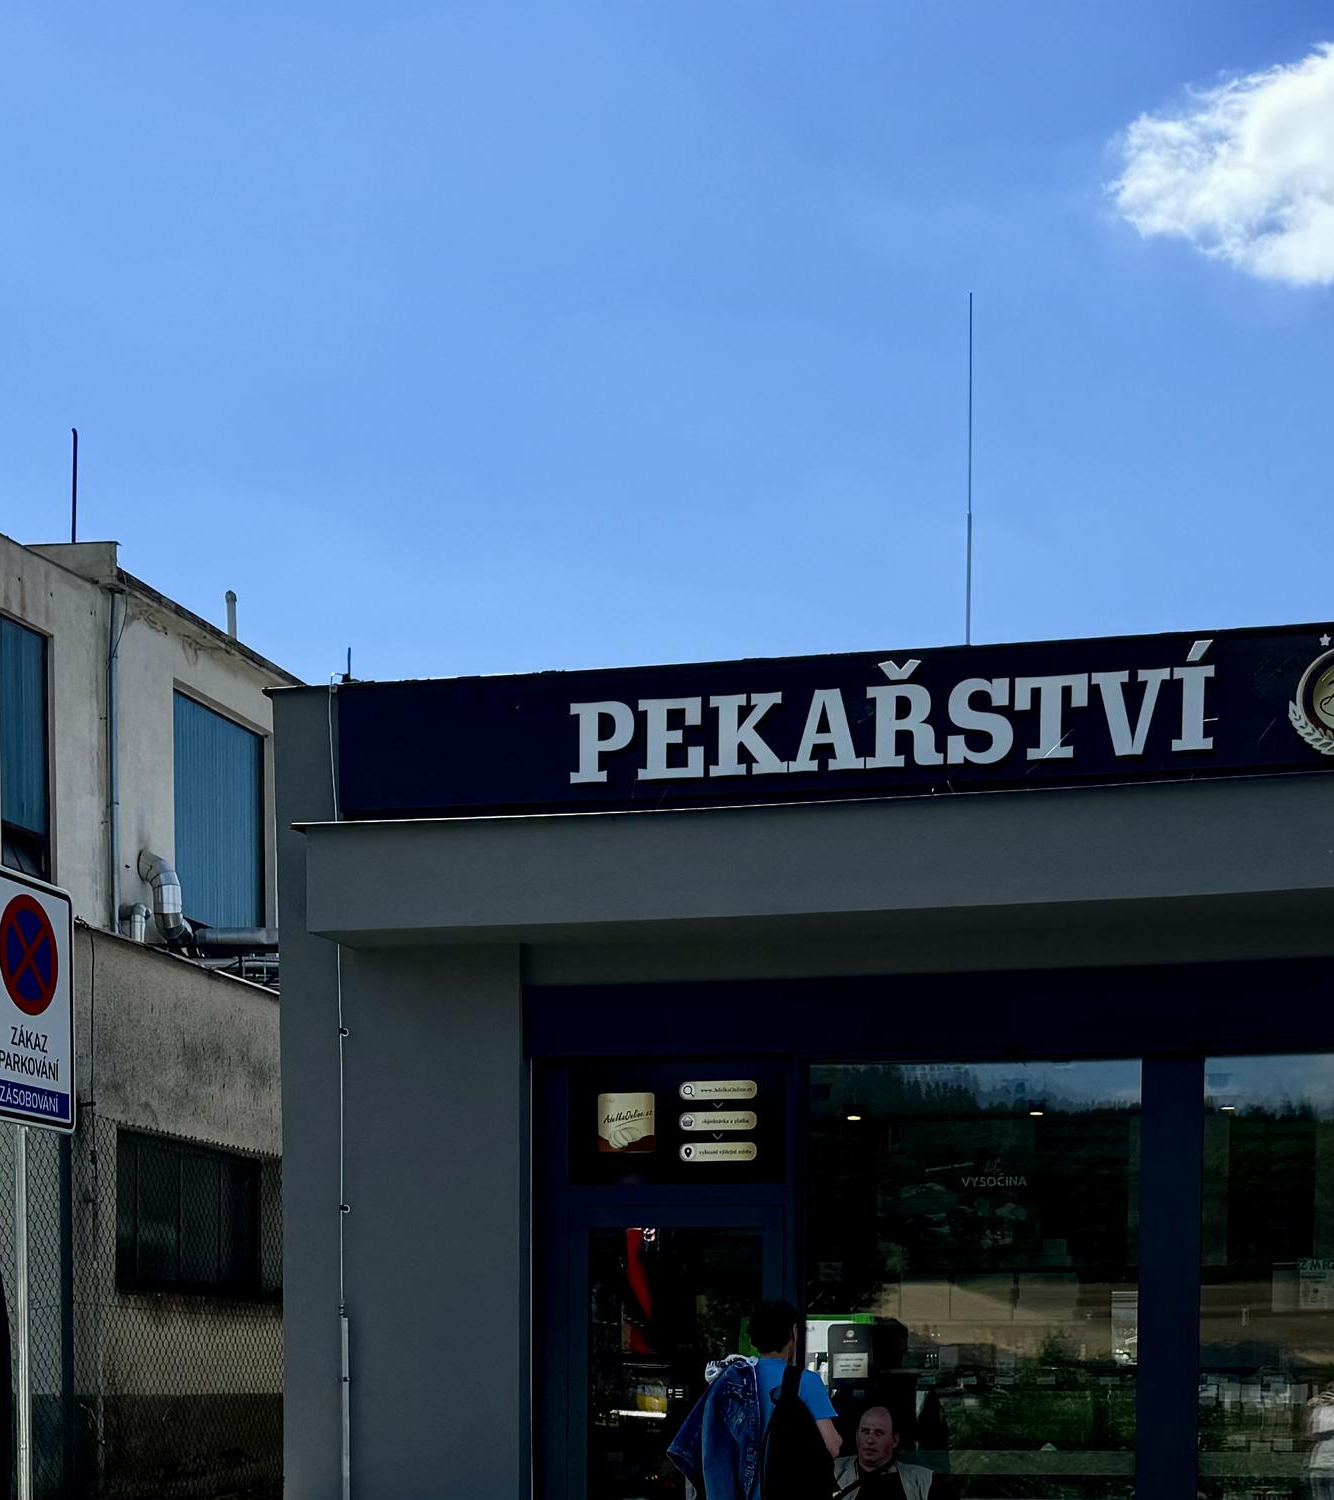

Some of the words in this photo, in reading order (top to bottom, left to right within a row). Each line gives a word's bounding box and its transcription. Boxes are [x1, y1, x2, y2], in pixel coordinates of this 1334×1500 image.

[568, 638, 1216, 785] PEKAŘSTVÍ
[10, 1024, 48, 1053] ZÁKAZ
[0, 1084, 59, 1113] ZÁSOBOVÁNÍ
[961, 1173, 1028, 1188] VYSOČINA
